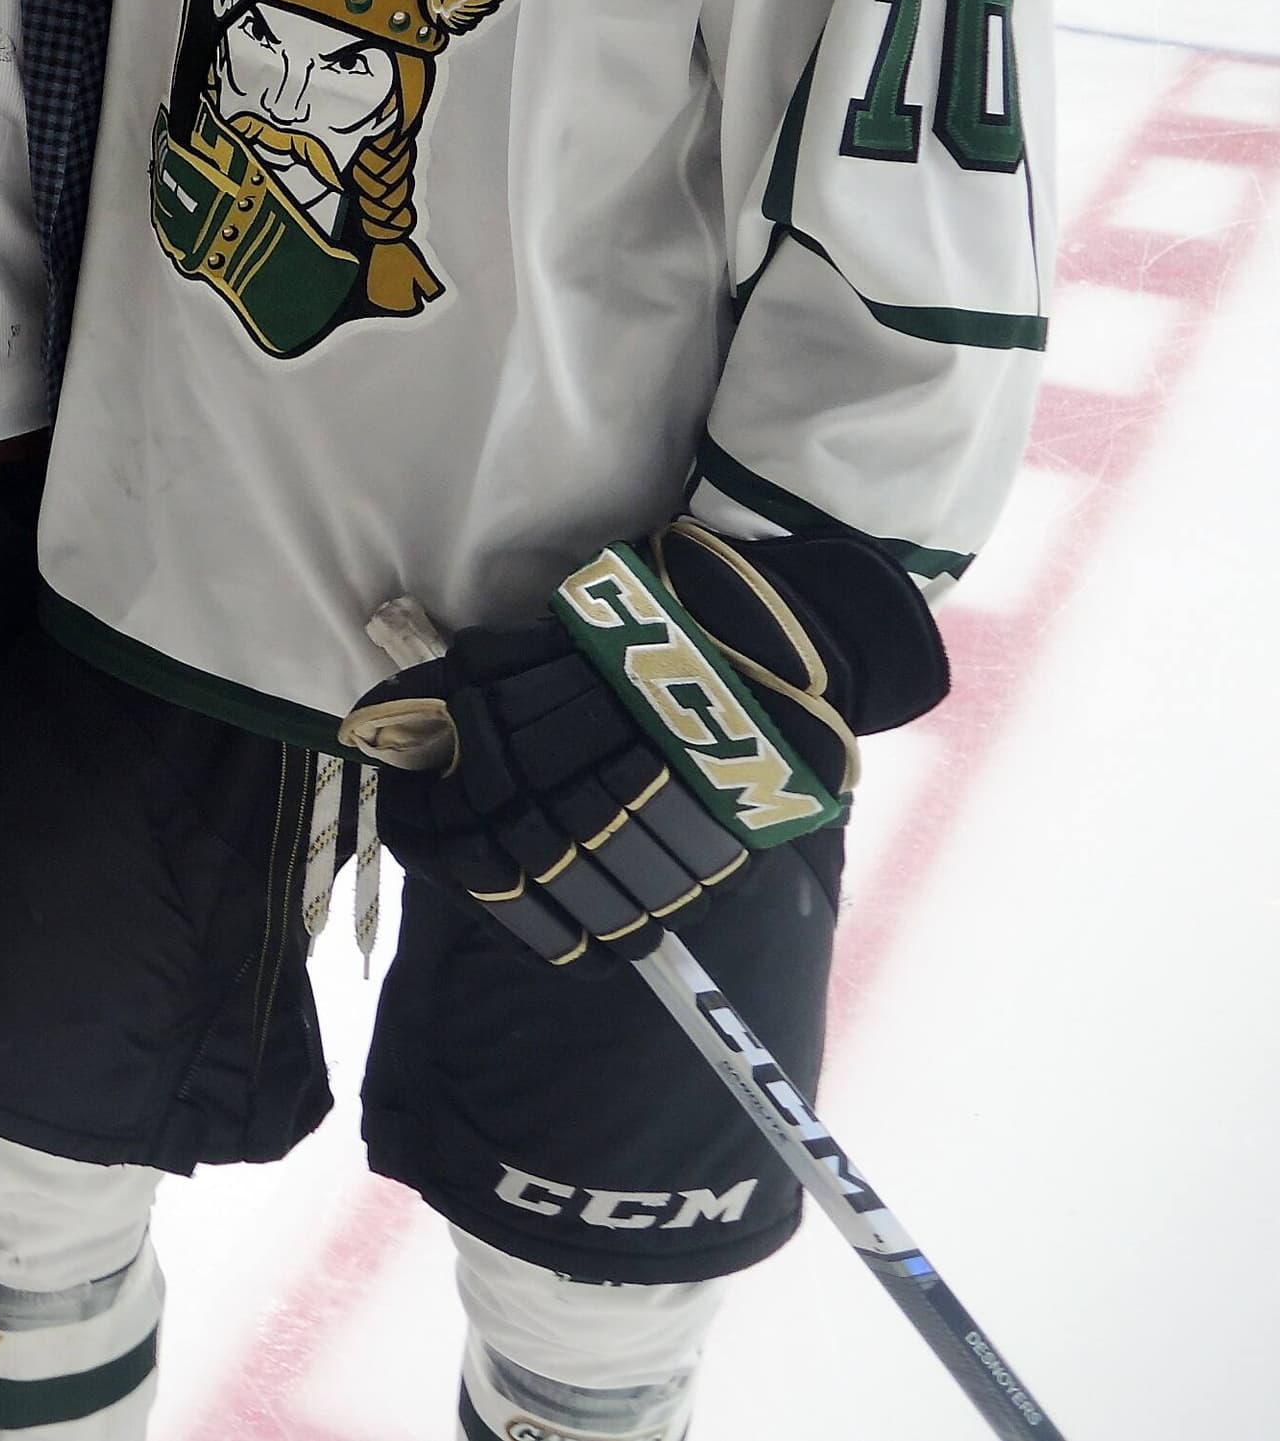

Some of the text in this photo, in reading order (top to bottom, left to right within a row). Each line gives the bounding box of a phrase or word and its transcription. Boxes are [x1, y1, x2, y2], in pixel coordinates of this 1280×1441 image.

[558, 549, 824, 830] CCM
[494, 1162, 759, 1229] CCM
[695, 989, 887, 1213] CCM
